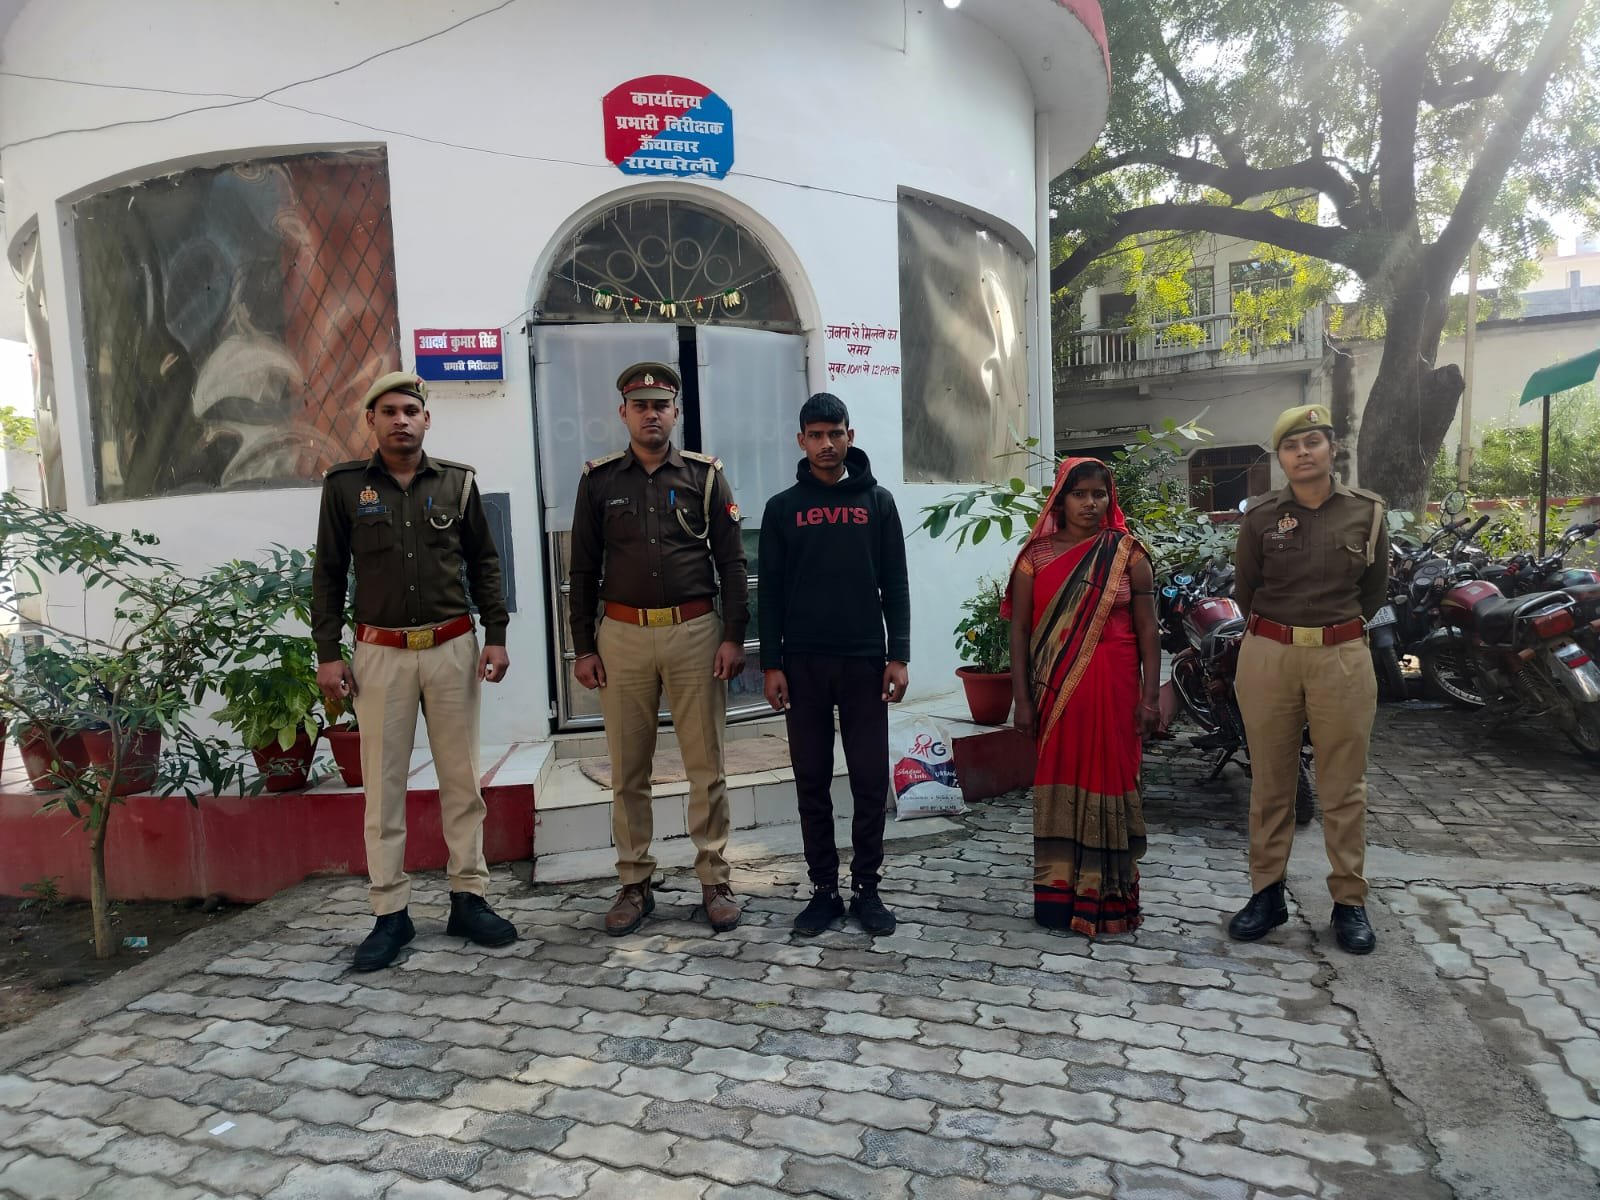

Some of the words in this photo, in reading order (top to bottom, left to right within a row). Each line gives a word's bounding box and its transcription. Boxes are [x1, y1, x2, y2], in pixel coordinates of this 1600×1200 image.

[630, 91, 702, 109] कार्यालय
[615, 114, 659, 130] प्रभारी
[664, 115, 724, 134] निरीक्षक
[624, 156, 719, 172] रायबरेली
[824, 325, 851, 339] जनता
[851, 322, 860, 340] से
[861, 323, 887, 340] मिलने
[887, 329, 899, 340] का
[450, 335, 476, 352] कुमार
[478, 331, 497, 348] सिंह
[847, 344, 872, 356] समय
[828, 363, 847, 381] सुबह
